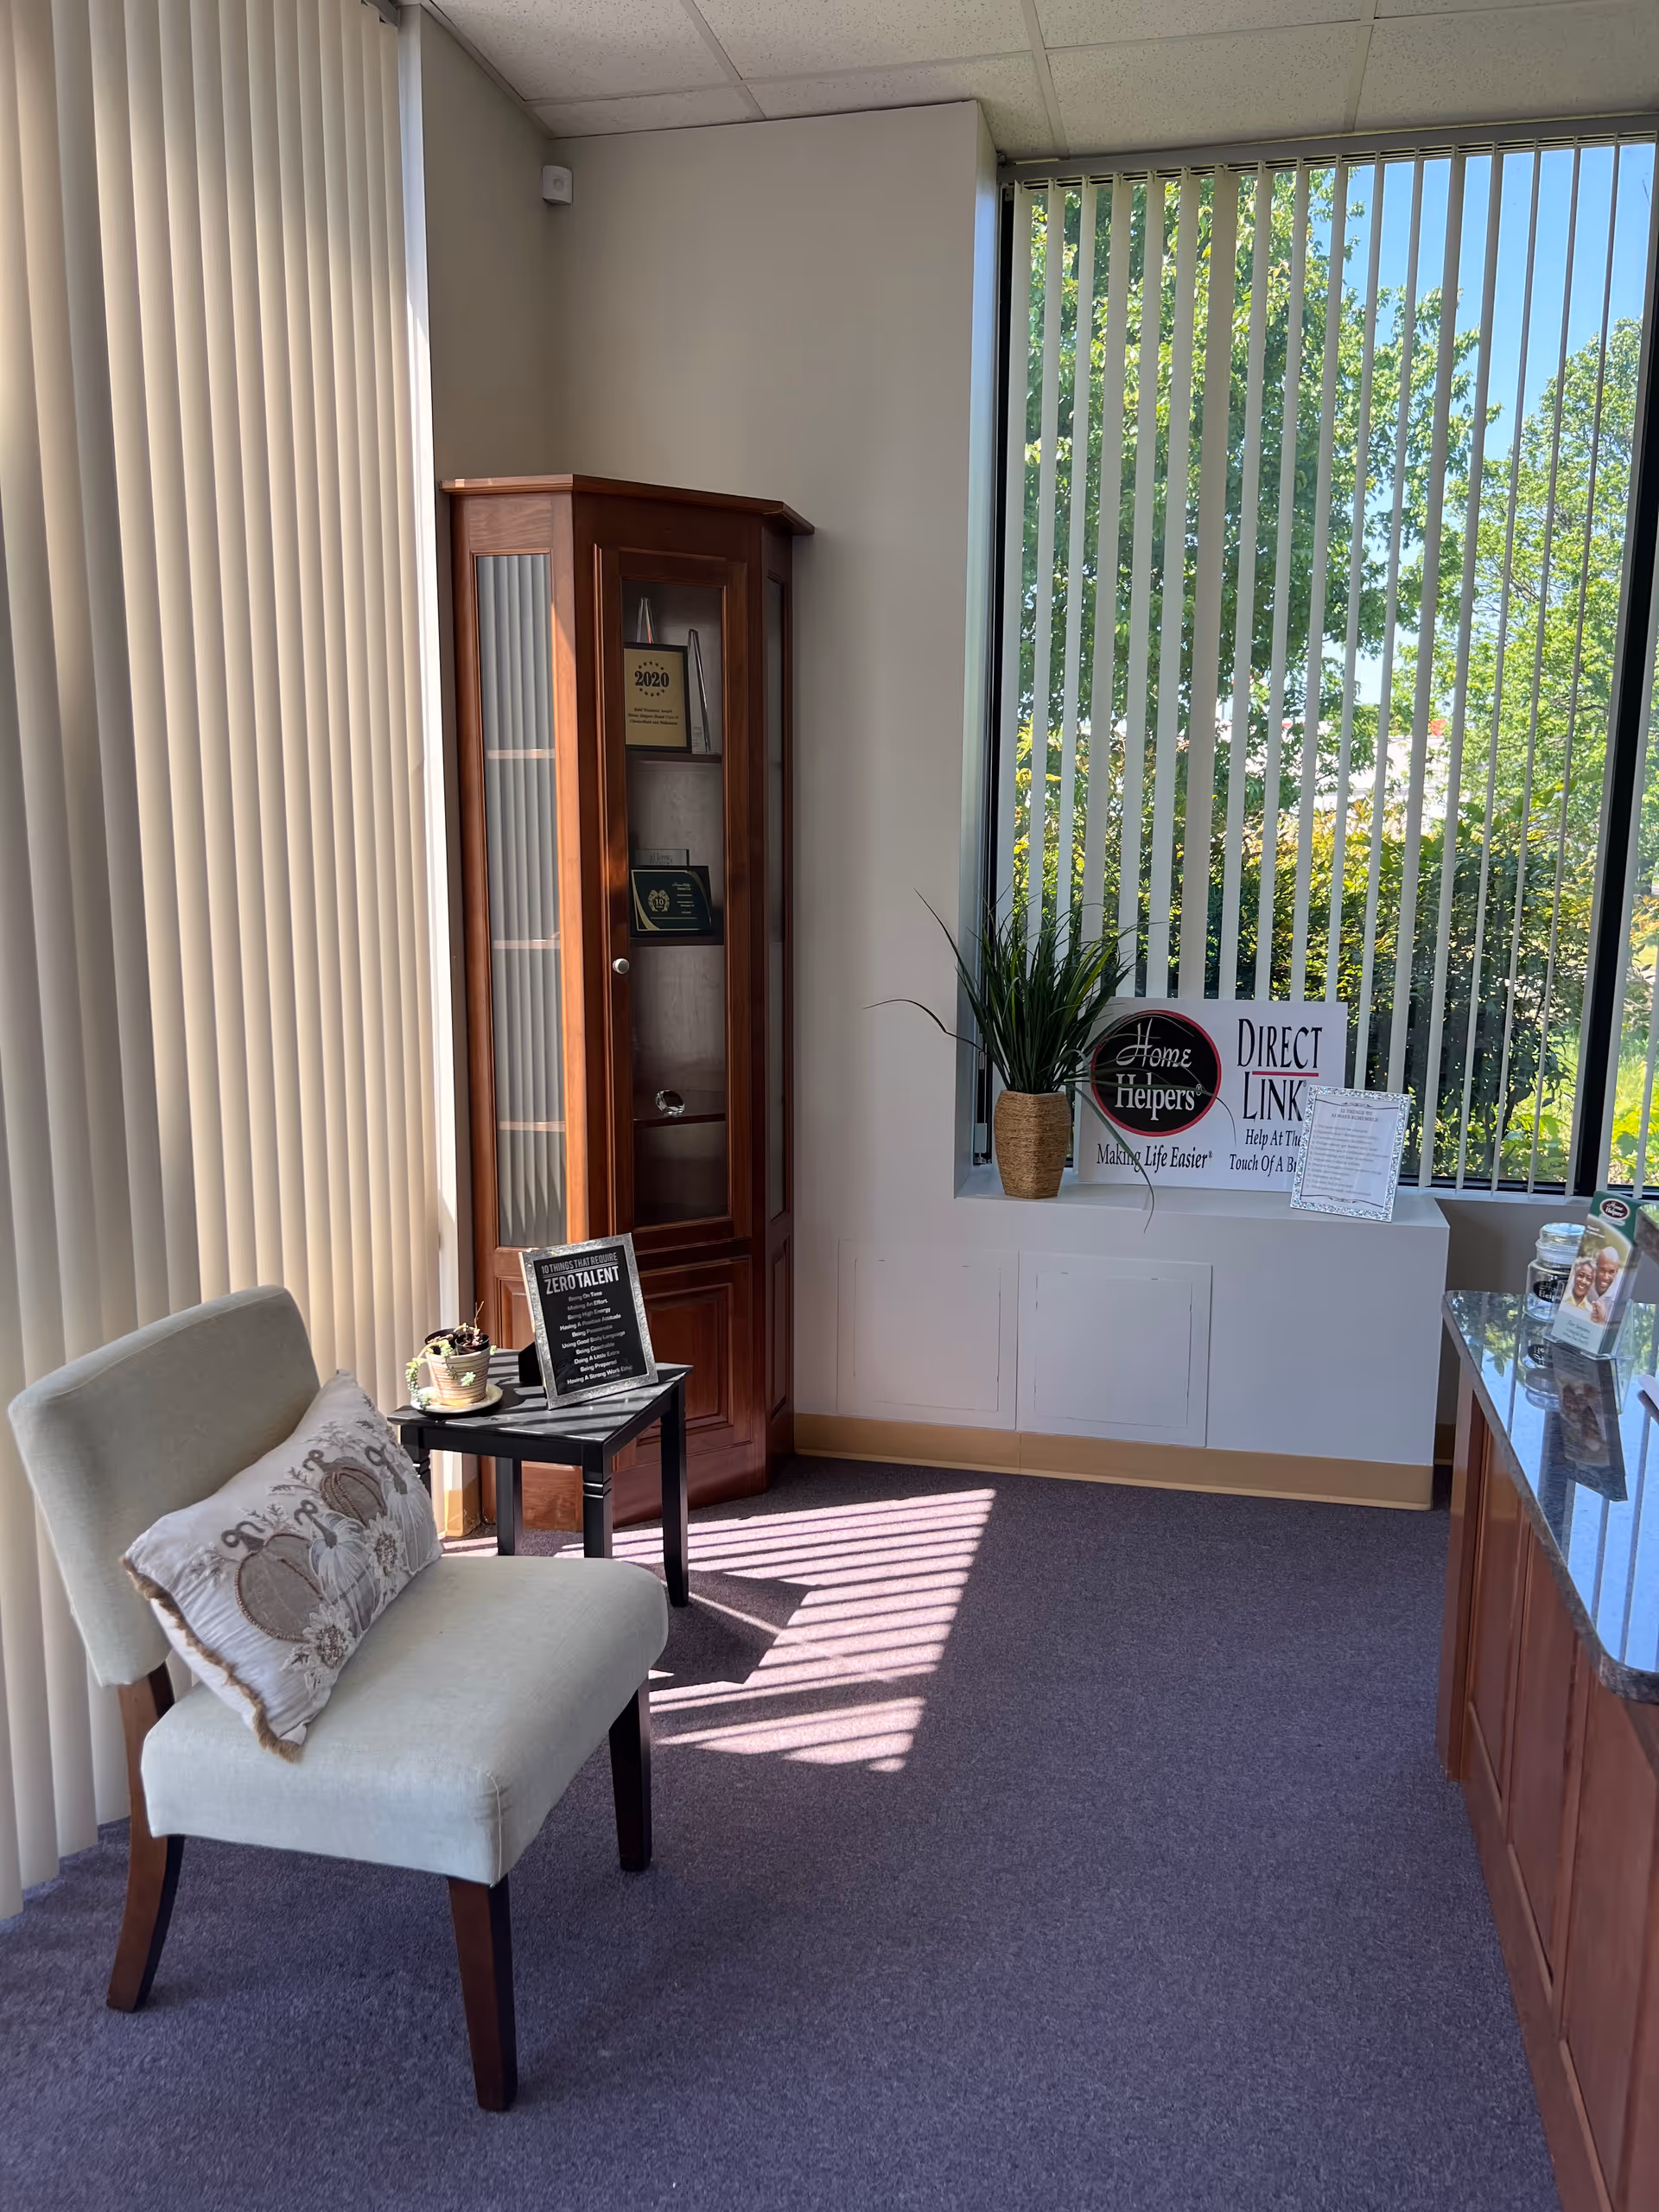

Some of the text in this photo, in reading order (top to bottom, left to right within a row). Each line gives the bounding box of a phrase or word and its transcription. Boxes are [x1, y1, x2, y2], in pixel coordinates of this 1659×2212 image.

[634, 671, 669, 687] 2020
[1116, 1018, 1192, 1068] Home
[1237, 1018, 1322, 1069] DIRECT
[1245, 1129, 1268, 1150] Help
[1270, 1130, 1283, 1146] At
[1097, 1143, 1141, 1173] Making
[1144, 1145, 1168, 1173] Life
[1229, 1154, 1258, 1170] Touch
[1261, 1155, 1275, 1177] Of
[1275, 1156, 1283, 1172] A
[541, 1252, 618, 1274] 10 THINGS THAT REQUIRE
[544, 1266, 619, 1295] ZERO TALENT
